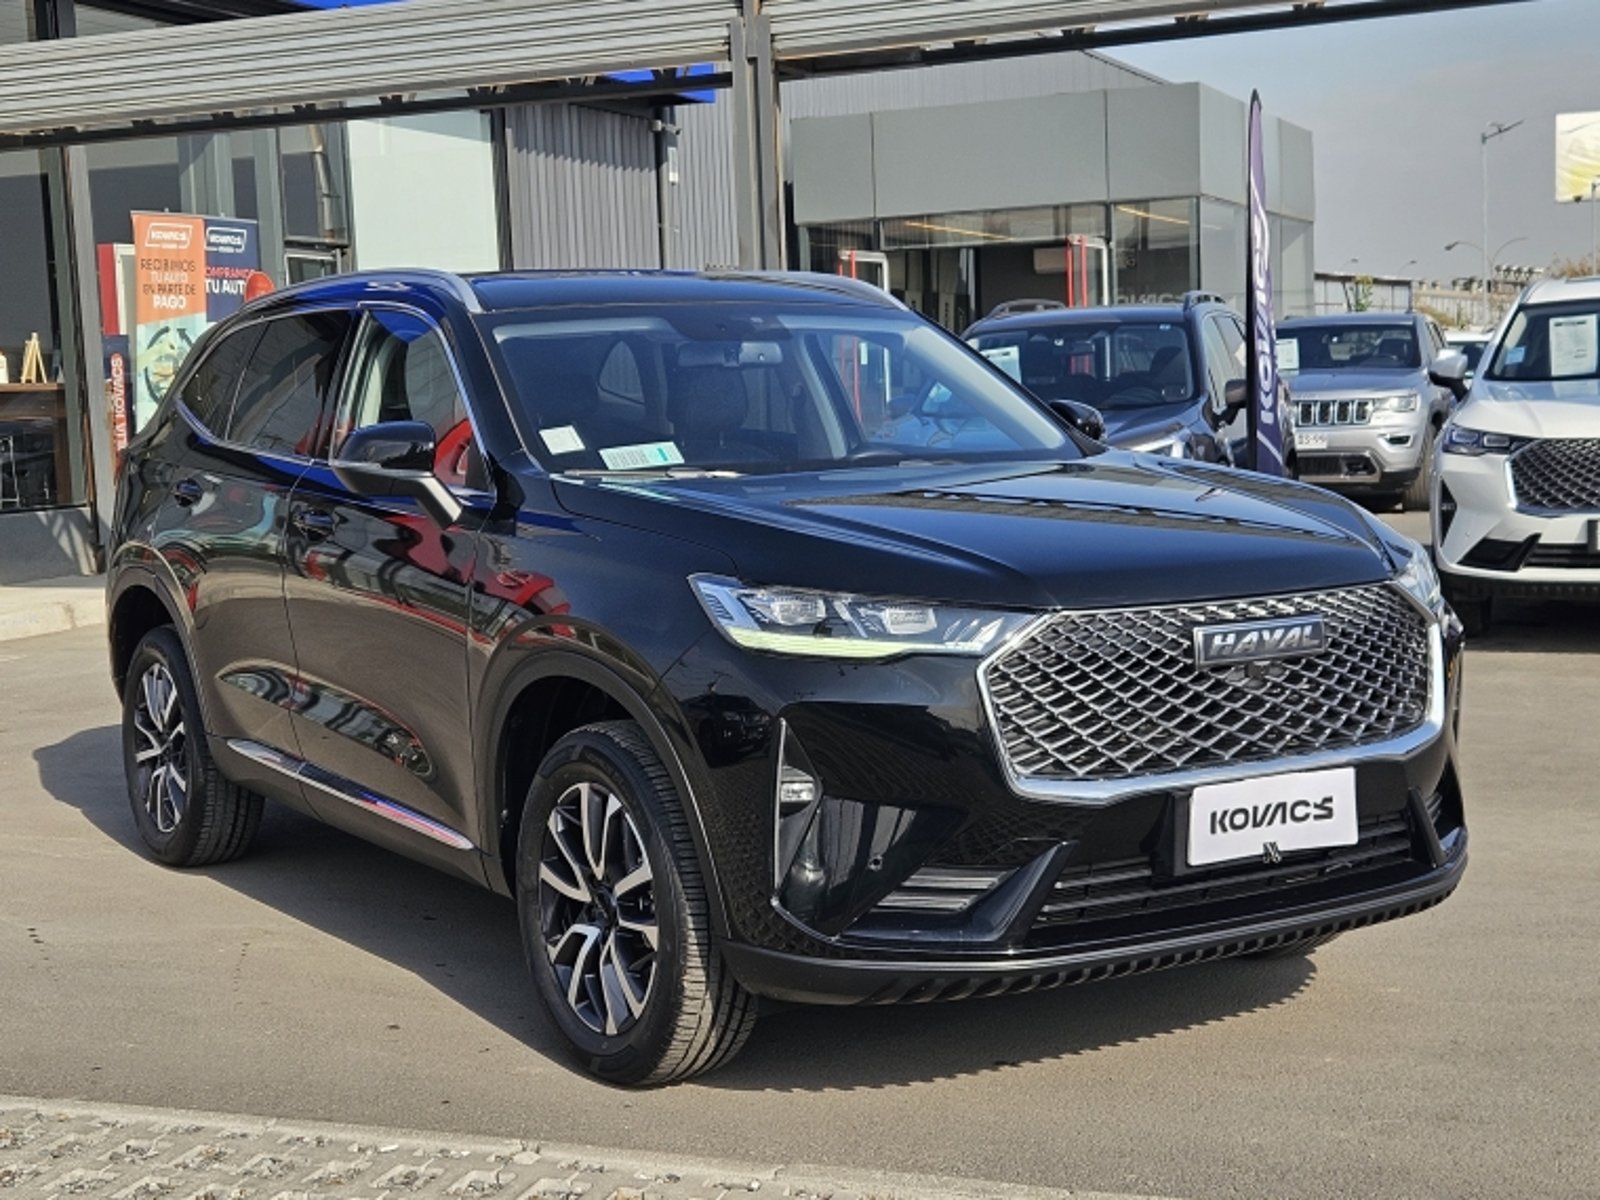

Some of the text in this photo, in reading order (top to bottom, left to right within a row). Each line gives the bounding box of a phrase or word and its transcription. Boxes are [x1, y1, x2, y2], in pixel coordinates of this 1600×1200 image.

[140, 258, 196, 272] RECIBIMOS
[151, 271, 163, 283] TU
[157, 284, 182, 295] PARTE
[184, 284, 196, 295] DE
[205, 279, 246, 294] TU AUT
[153, 294, 187, 309] PAGO
[111, 358, 126, 418] KOVACS
[1209, 624, 1321, 656] HAVAL
[1209, 796, 1334, 835] KOVACS
